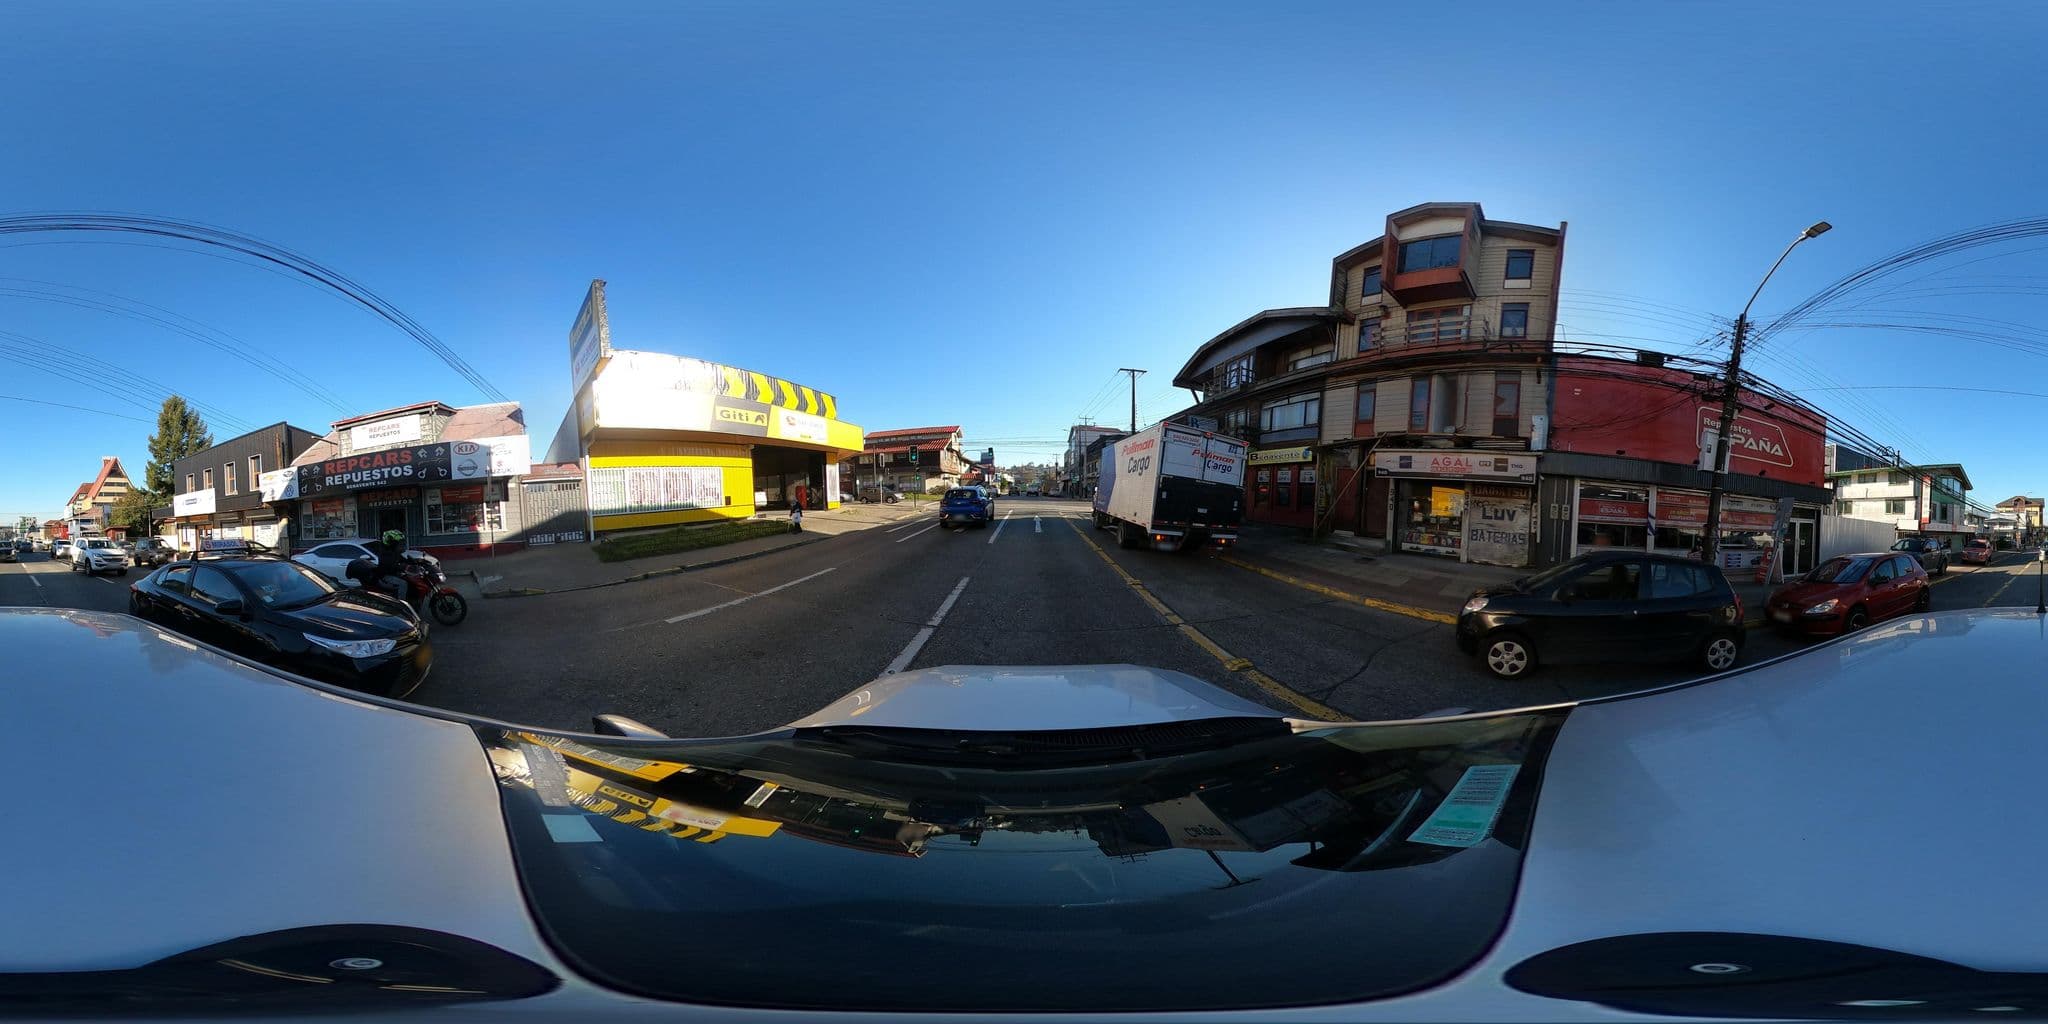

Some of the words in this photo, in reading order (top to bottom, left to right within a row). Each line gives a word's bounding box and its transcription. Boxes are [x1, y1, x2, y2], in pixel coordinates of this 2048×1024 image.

[720, 410, 749, 421] Giti
[369, 423, 401, 434] REPCARS
[369, 430, 401, 439] REPUESTOS
[1731, 434, 1784, 457] PAÑA
[325, 450, 413, 475] REPCARS
[1128, 456, 1150, 476] Cargo
[1207, 460, 1233, 473] Cargo
[1431, 456, 1473, 467] AGAL
[325, 465, 414, 487] REPUESTOS
[1482, 507, 1517, 522] LUV
[1471, 529, 1526, 545] BATERIAS
